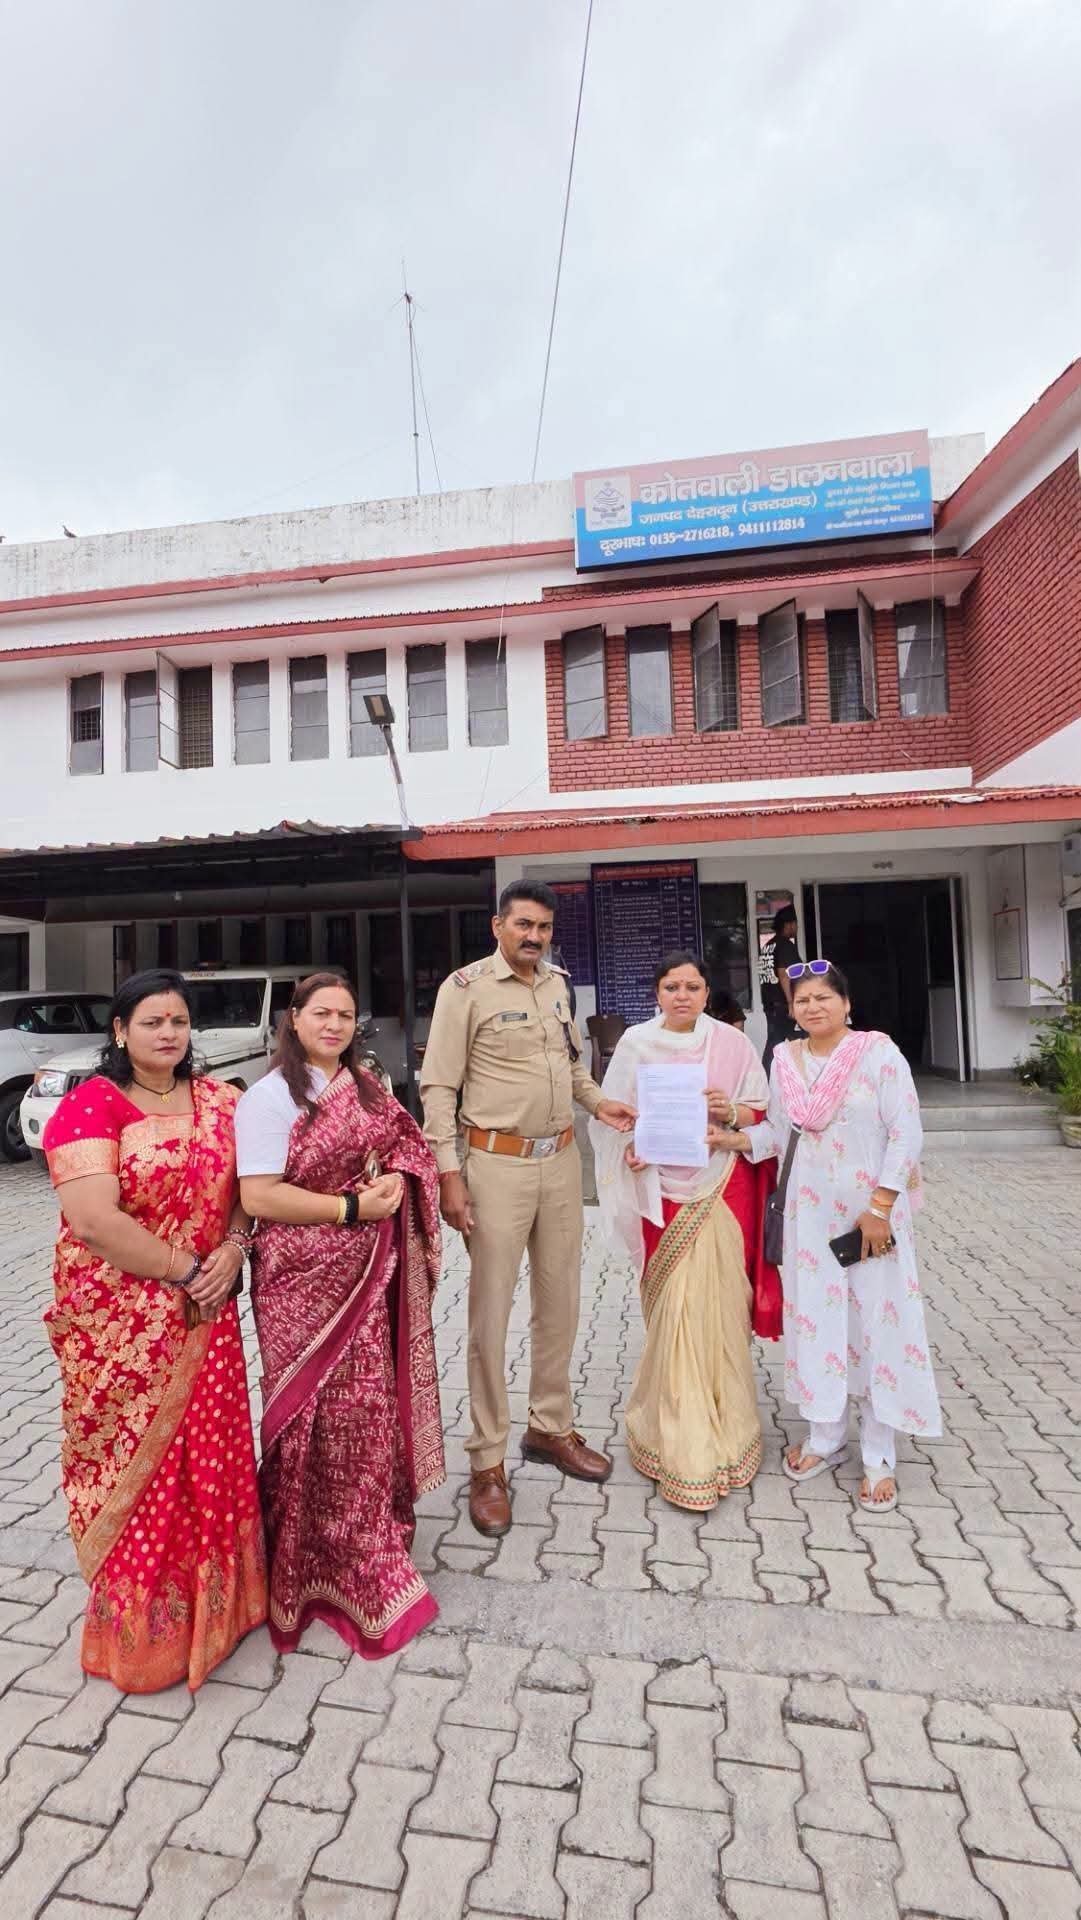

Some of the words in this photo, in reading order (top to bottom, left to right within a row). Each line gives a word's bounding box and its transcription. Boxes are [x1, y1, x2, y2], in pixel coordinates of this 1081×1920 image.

[639, 459, 761, 505] कोतवाली
[767, 450, 914, 492] डालनवाला
[639, 510, 683, 525] जनपद
[687, 503, 737, 521] देहरादून
